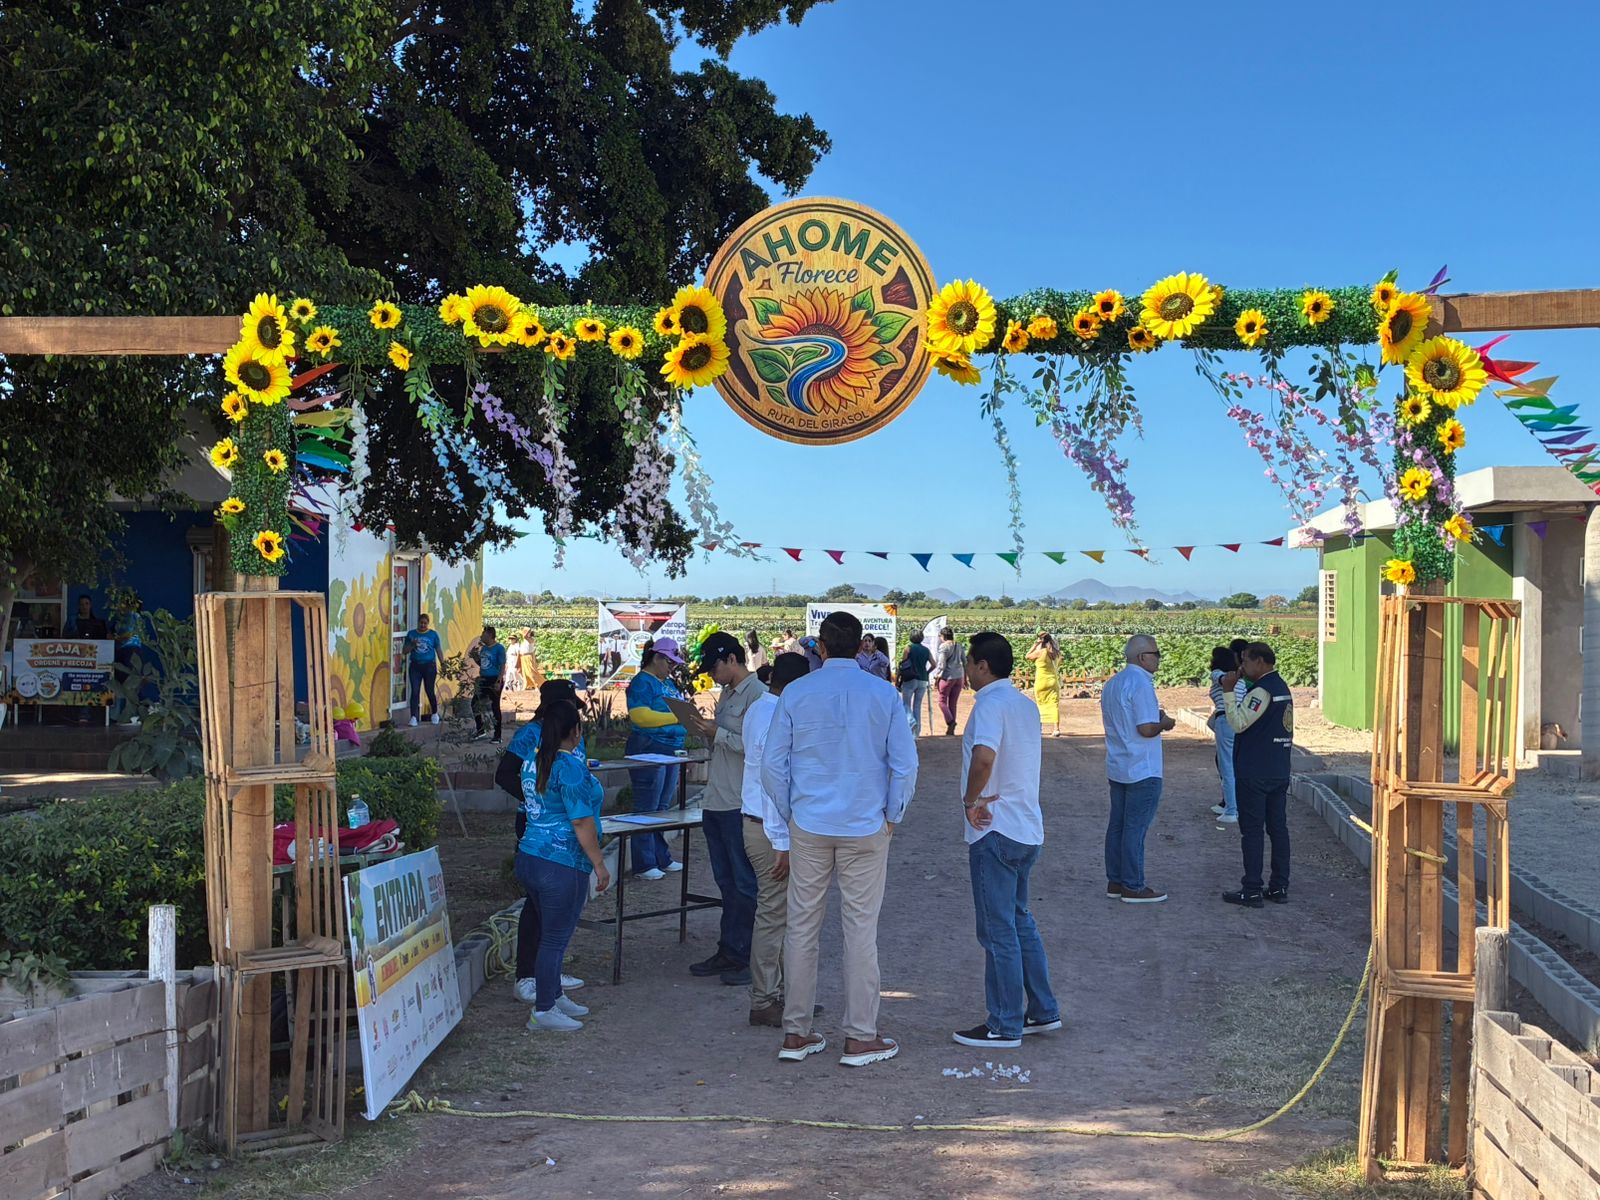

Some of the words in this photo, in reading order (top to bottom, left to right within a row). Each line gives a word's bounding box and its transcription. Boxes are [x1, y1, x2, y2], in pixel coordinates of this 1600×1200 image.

[740, 219, 899, 281] AHOME
[777, 261, 859, 284] Florece
[767, 408, 796, 426] RUTA
[798, 417, 819, 430] DEL
[821, 410, 870, 430] GIRASOL
[863, 623, 890, 631] ORECE!
[46, 643, 81, 655] CAJA
[373, 869, 428, 944] ENTRADA
